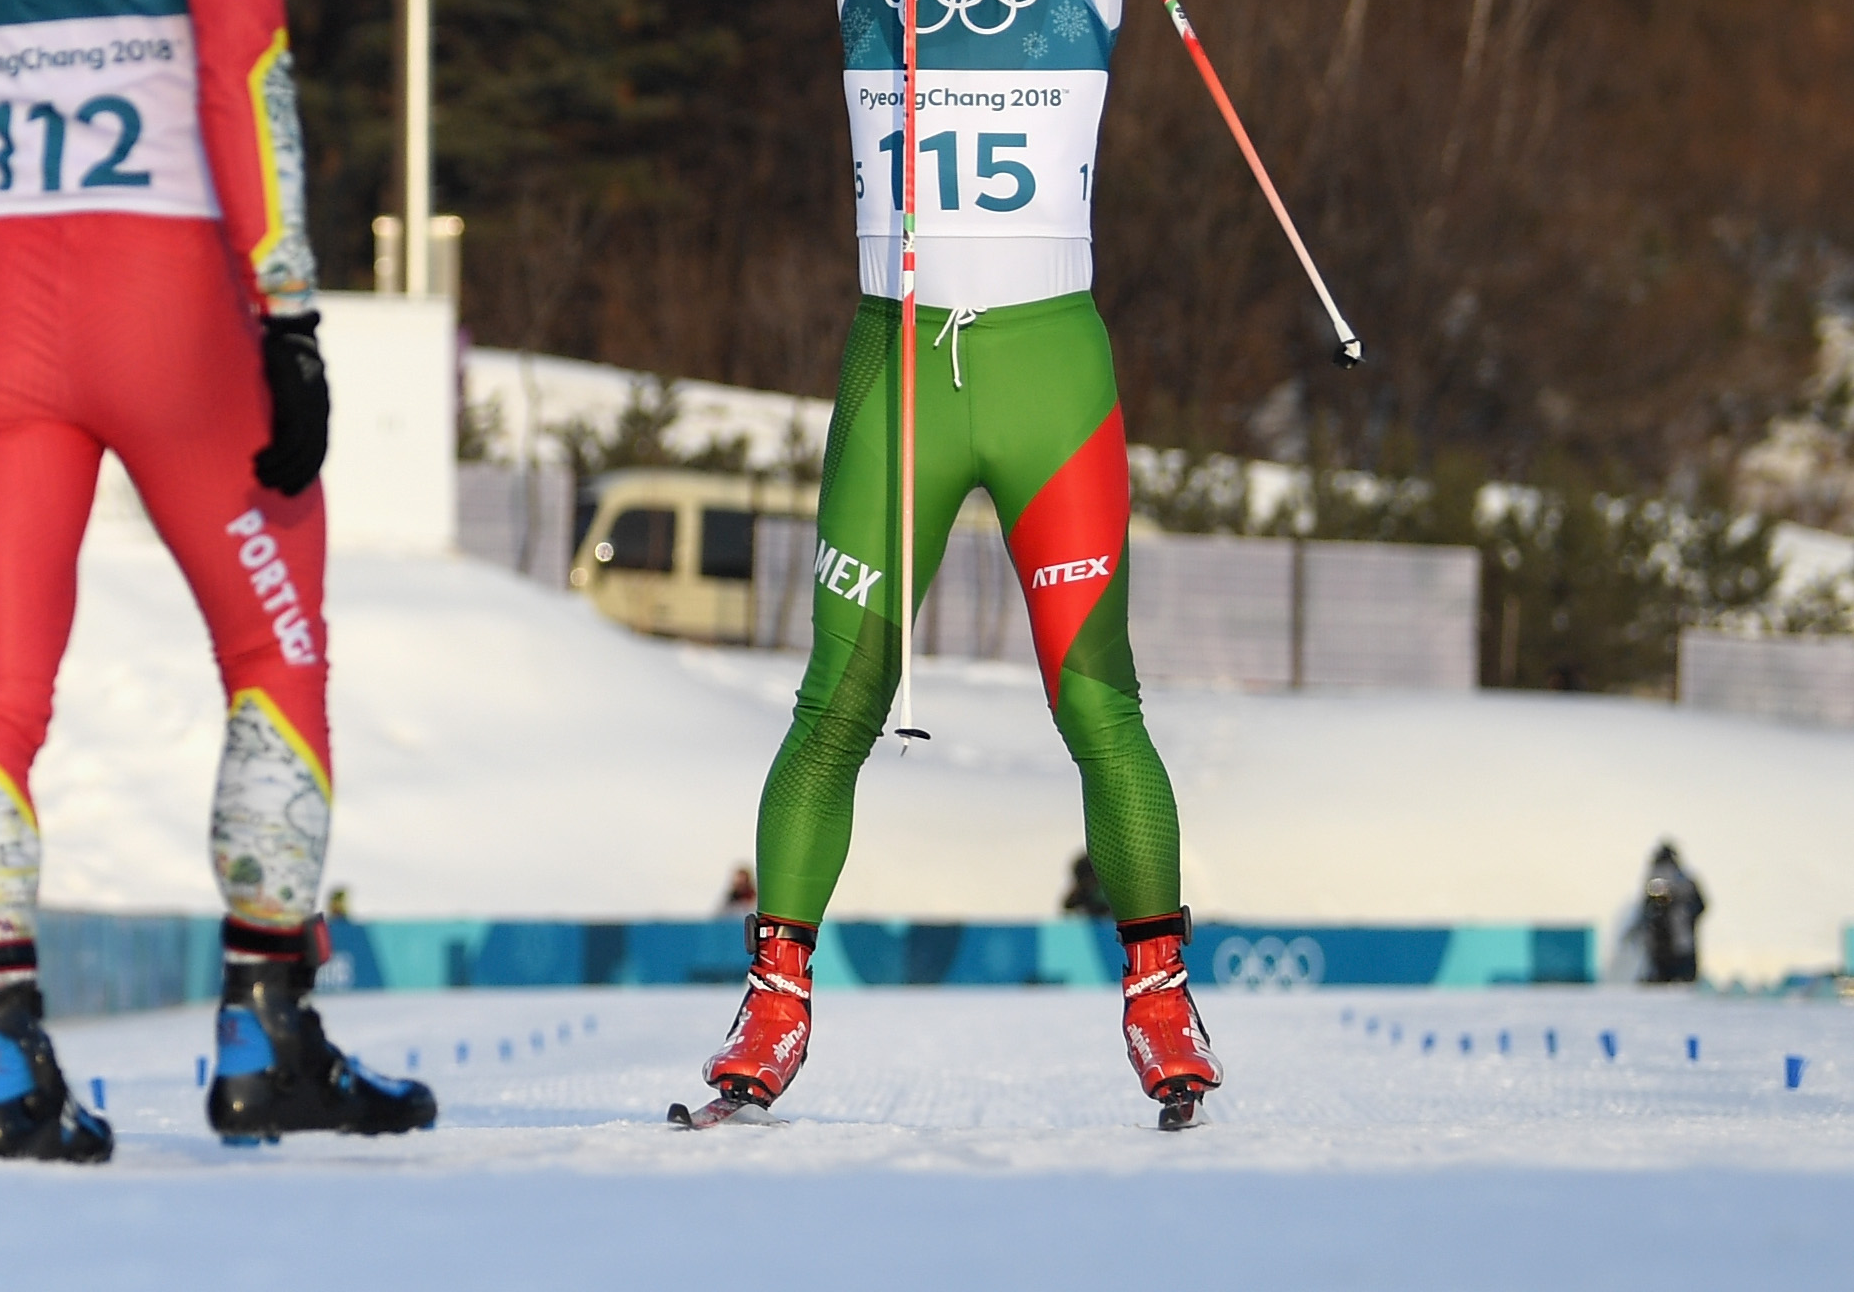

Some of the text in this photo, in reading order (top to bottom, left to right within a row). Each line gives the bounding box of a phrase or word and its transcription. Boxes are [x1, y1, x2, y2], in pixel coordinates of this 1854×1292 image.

[859, 87, 1006, 112] PyeogChang
[879, 130, 1037, 213] 115
[814, 538, 883, 608] MEX
[1032, 555, 1110, 589] ATEX
[766, 972, 810, 999] alpina
[1125, 970, 1167, 997] alpina
[772, 1020, 806, 1064] alpina
